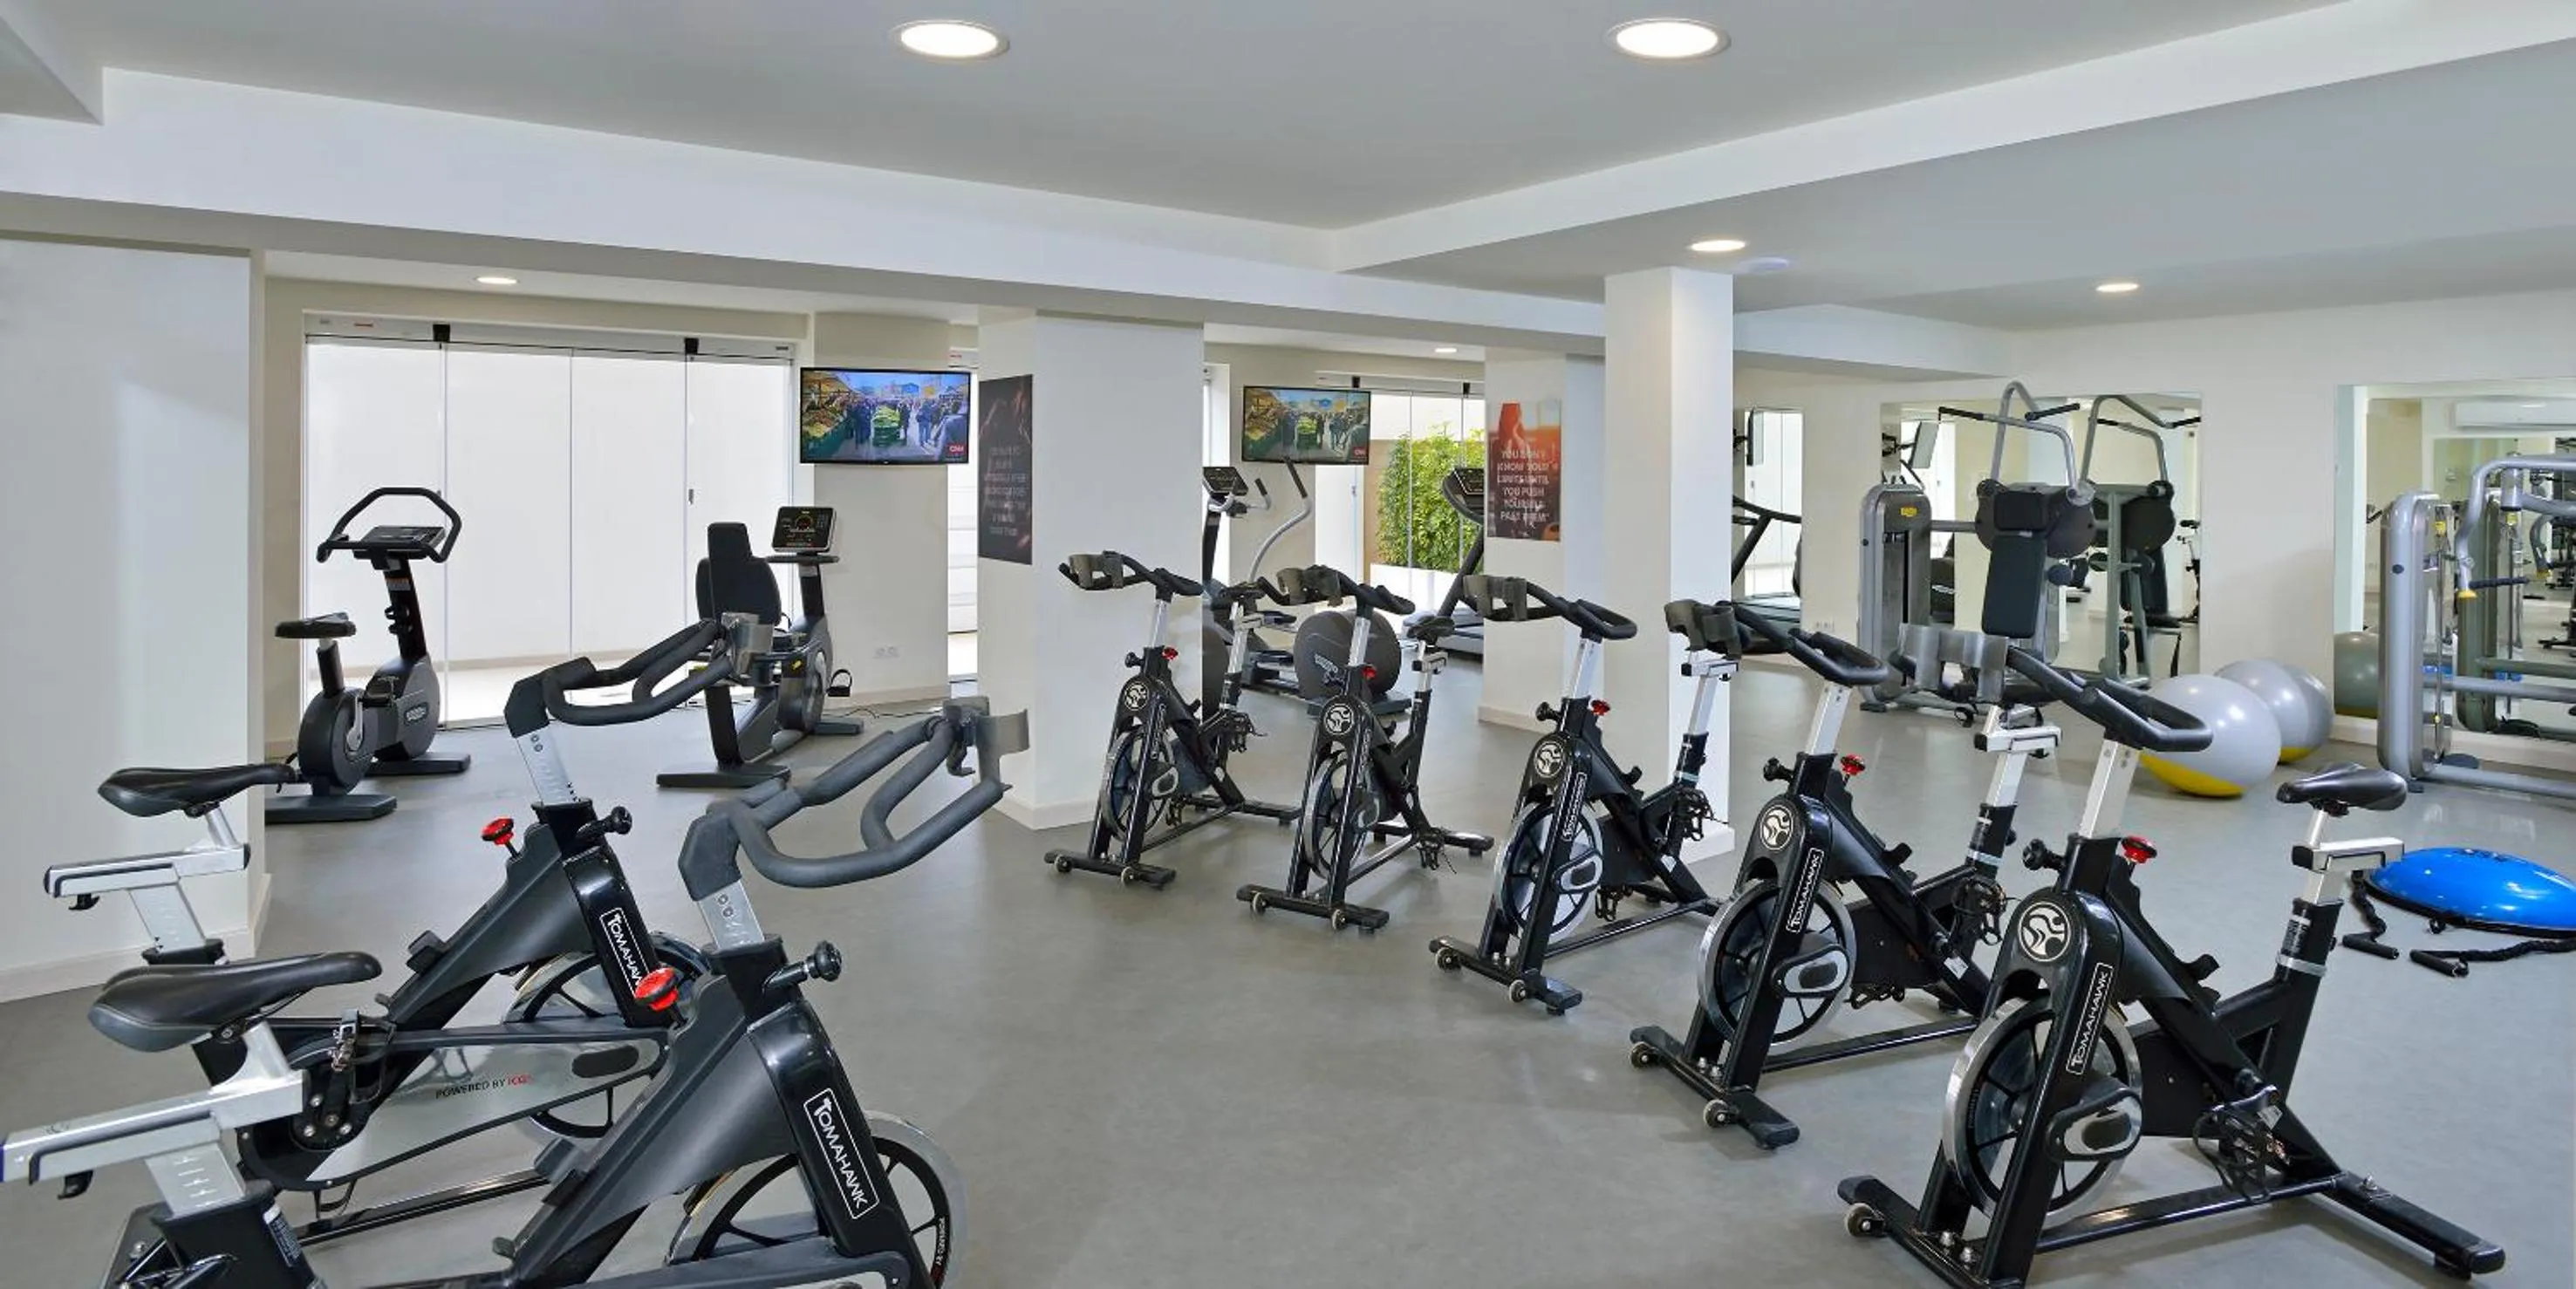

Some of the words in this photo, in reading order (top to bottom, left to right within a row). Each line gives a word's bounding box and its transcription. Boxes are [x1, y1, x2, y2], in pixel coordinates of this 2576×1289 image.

[607, 913, 643, 986] TOMAHAW
[2071, 972, 2108, 1066] TOMAHAWK
[436, 1081, 489, 1099] POWERED
[492, 1079, 506, 1089] BY
[813, 1097, 868, 1209] TOMAHAWK
